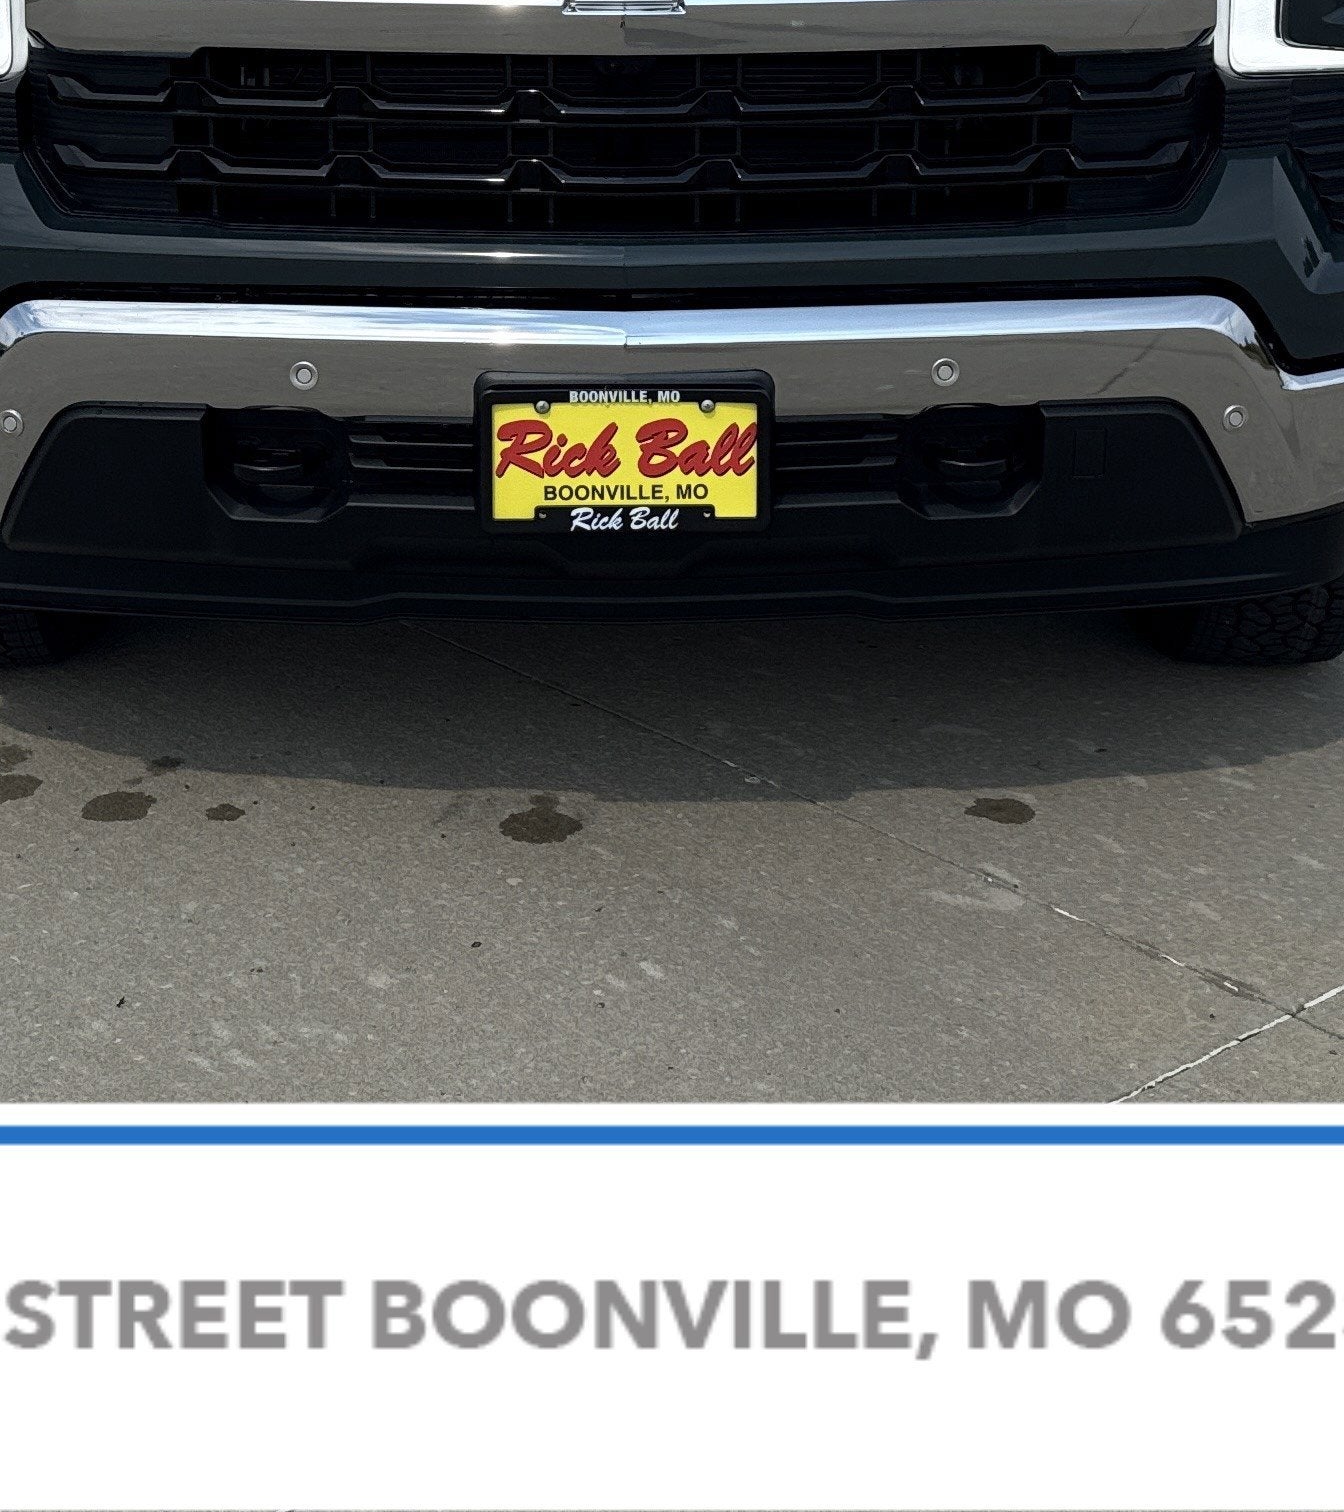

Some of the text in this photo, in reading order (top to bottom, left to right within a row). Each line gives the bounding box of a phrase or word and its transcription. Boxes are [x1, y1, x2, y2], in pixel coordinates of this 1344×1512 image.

[569, 390, 681, 405] BOONVILLE, MO
[495, 417, 758, 480] Rick Ball
[543, 483, 709, 503] BOONVILLE, MO
[570, 506, 680, 532] Rick Ball
